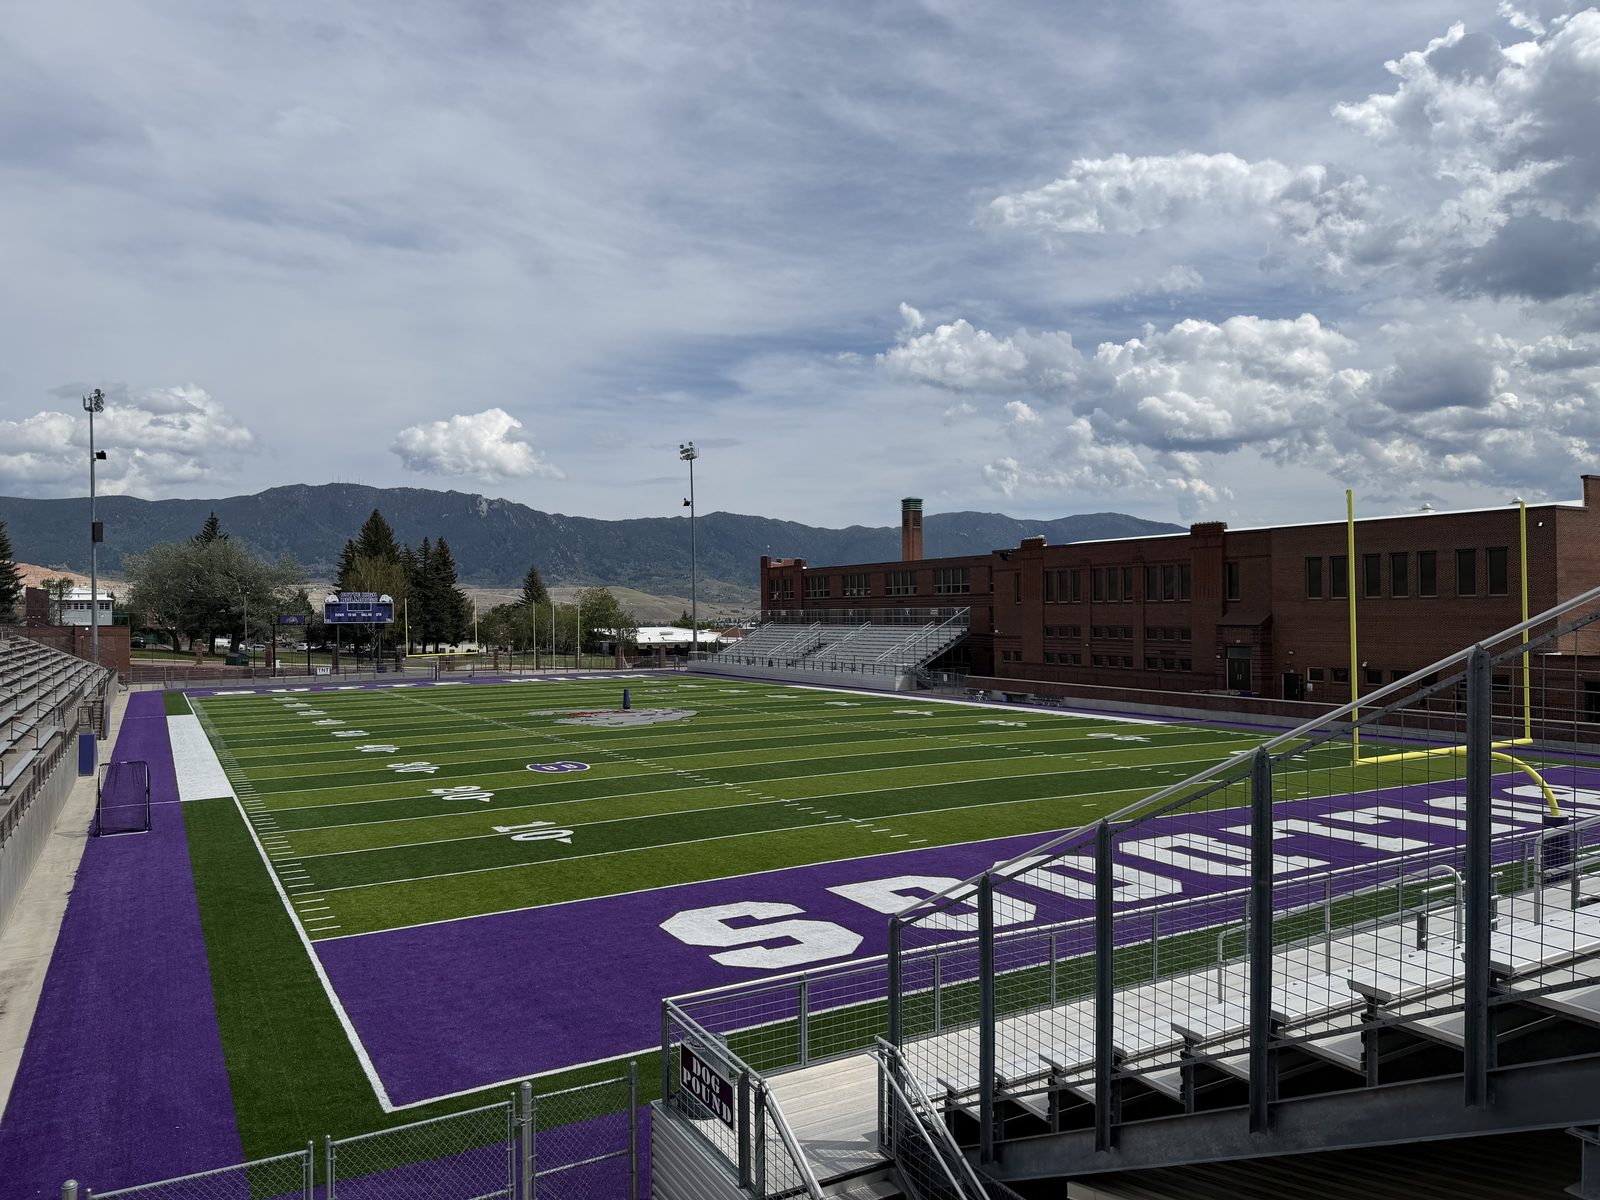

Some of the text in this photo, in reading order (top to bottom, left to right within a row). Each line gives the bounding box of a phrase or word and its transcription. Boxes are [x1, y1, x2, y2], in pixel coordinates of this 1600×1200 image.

[427, 785, 495, 801] 20
[491, 821, 574, 843] 10
[692, 1056, 720, 1094] DOG
[682, 1066, 732, 1123] POUND
